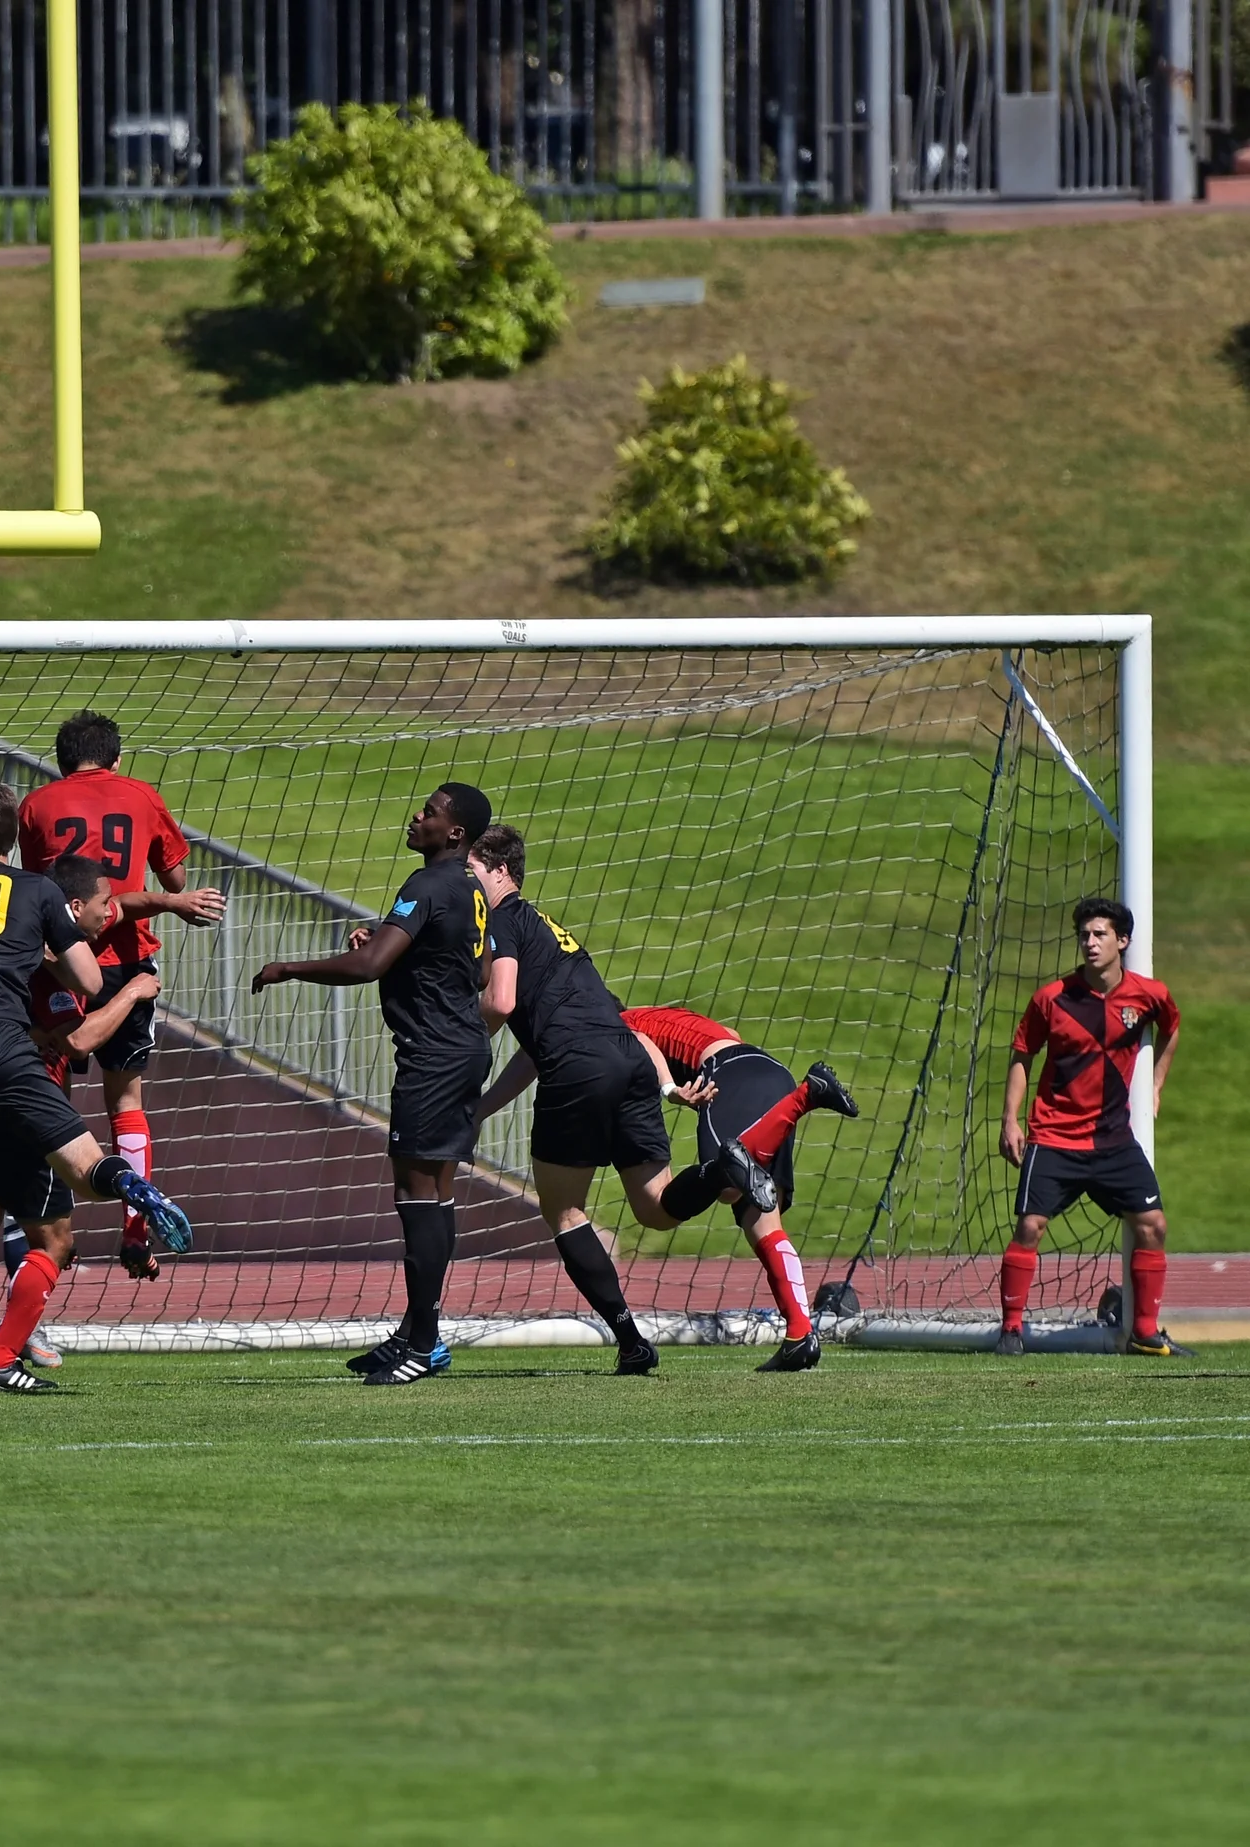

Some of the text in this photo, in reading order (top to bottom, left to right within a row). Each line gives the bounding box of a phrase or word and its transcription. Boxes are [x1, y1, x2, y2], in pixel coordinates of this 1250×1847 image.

[502, 629, 527, 643] GOALS
[54, 812, 133, 881] 29
[473, 888, 487, 959] 9
